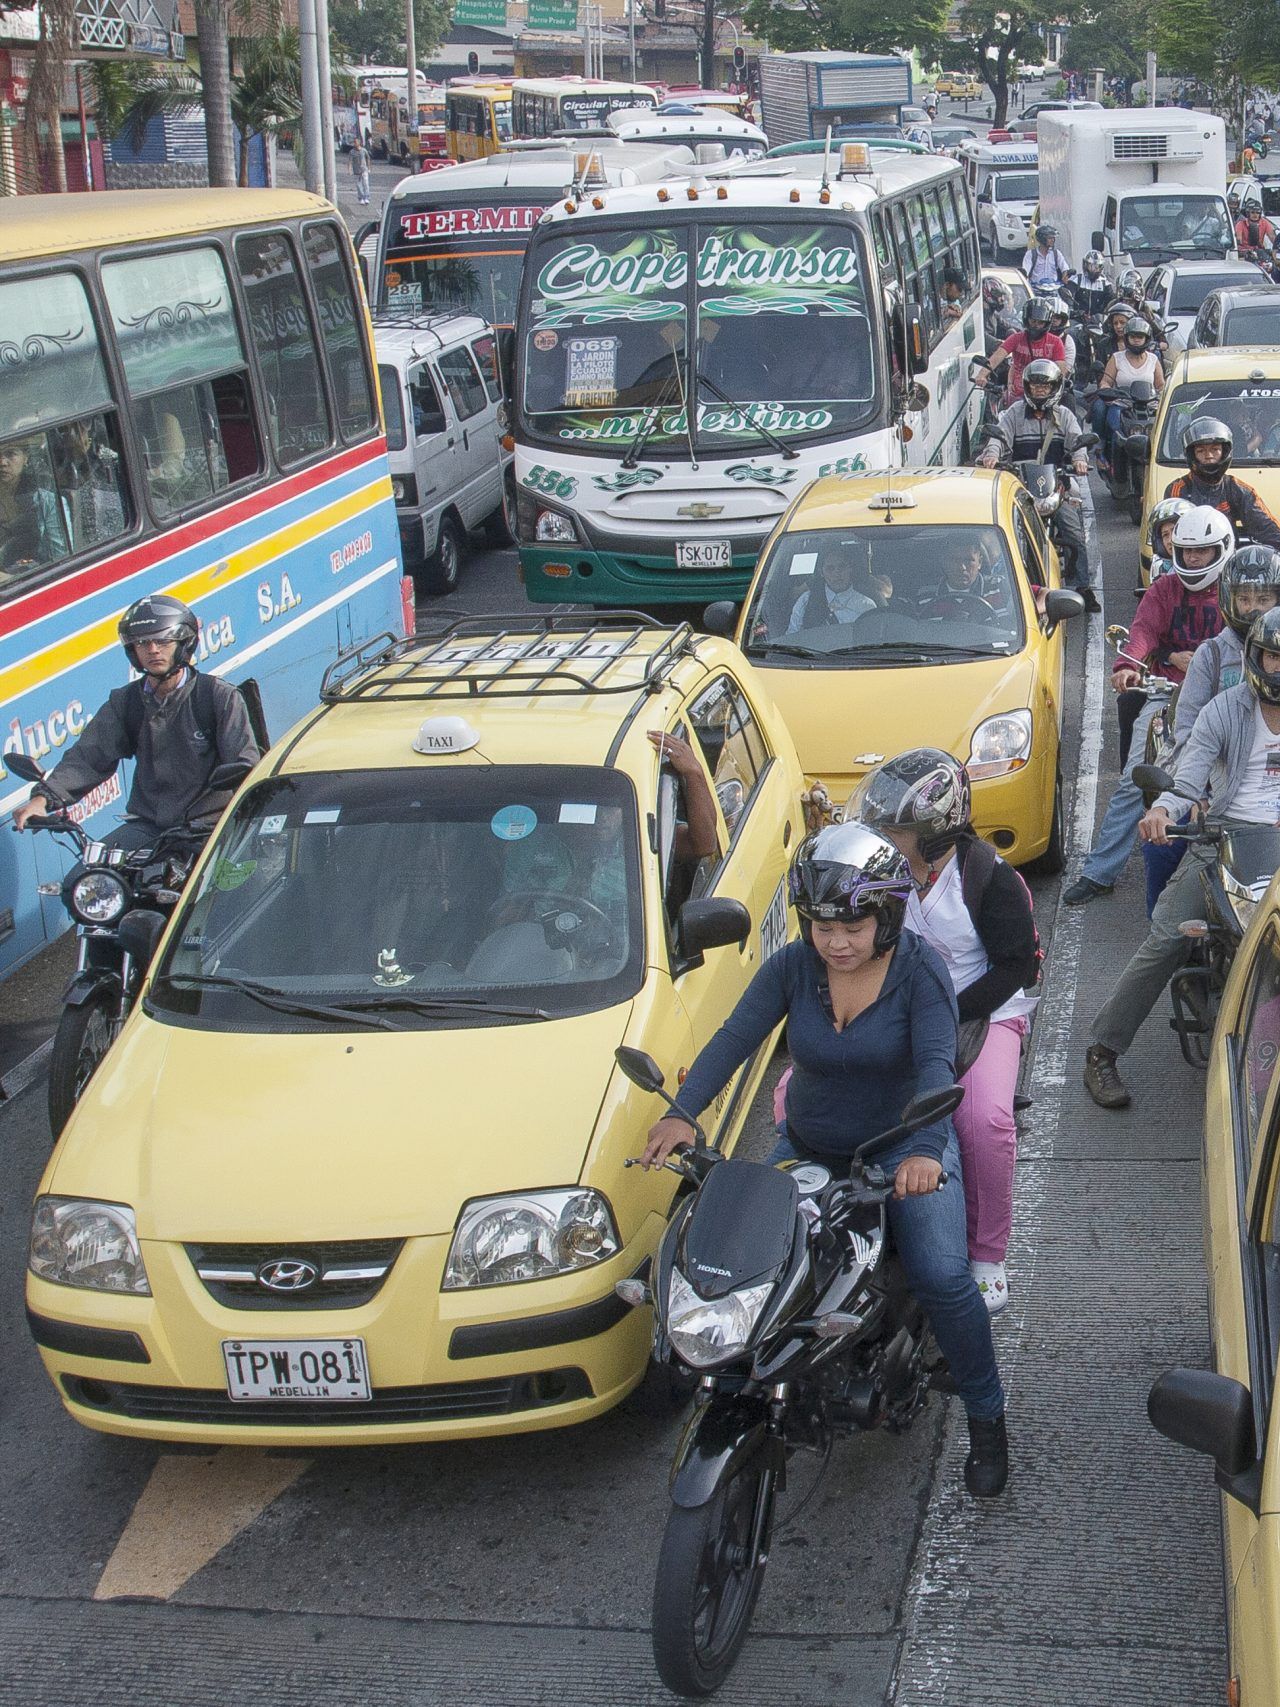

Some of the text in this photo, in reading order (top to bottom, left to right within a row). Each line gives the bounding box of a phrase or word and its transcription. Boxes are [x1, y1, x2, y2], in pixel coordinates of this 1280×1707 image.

[563, 99, 608, 111] Circular
[611, 99, 631, 109] Sur
[536, 236, 858, 301] Coopetransa
[389, 283, 422, 297] 287
[570, 340, 615, 352] 069
[570, 351, 614, 362] B. JARDIN
[570, 367, 614, 375] ECUADOR
[584, 360, 614, 368] PILOTO
[570, 373, 596, 381] CAMINO
[662, 401, 834, 435] destino
[522, 464, 582, 501] 556
[257, 570, 303, 625] S.A.
[0, 699, 94, 780] ducc.
[427, 735, 454, 749] TAXI
[811, 904, 846, 914] SHAFT
[868, 1240, 883, 1272] HONDA
[696, 1263, 733, 1278] HONDA
[269, 1386, 330, 1398] MEDELLIN
